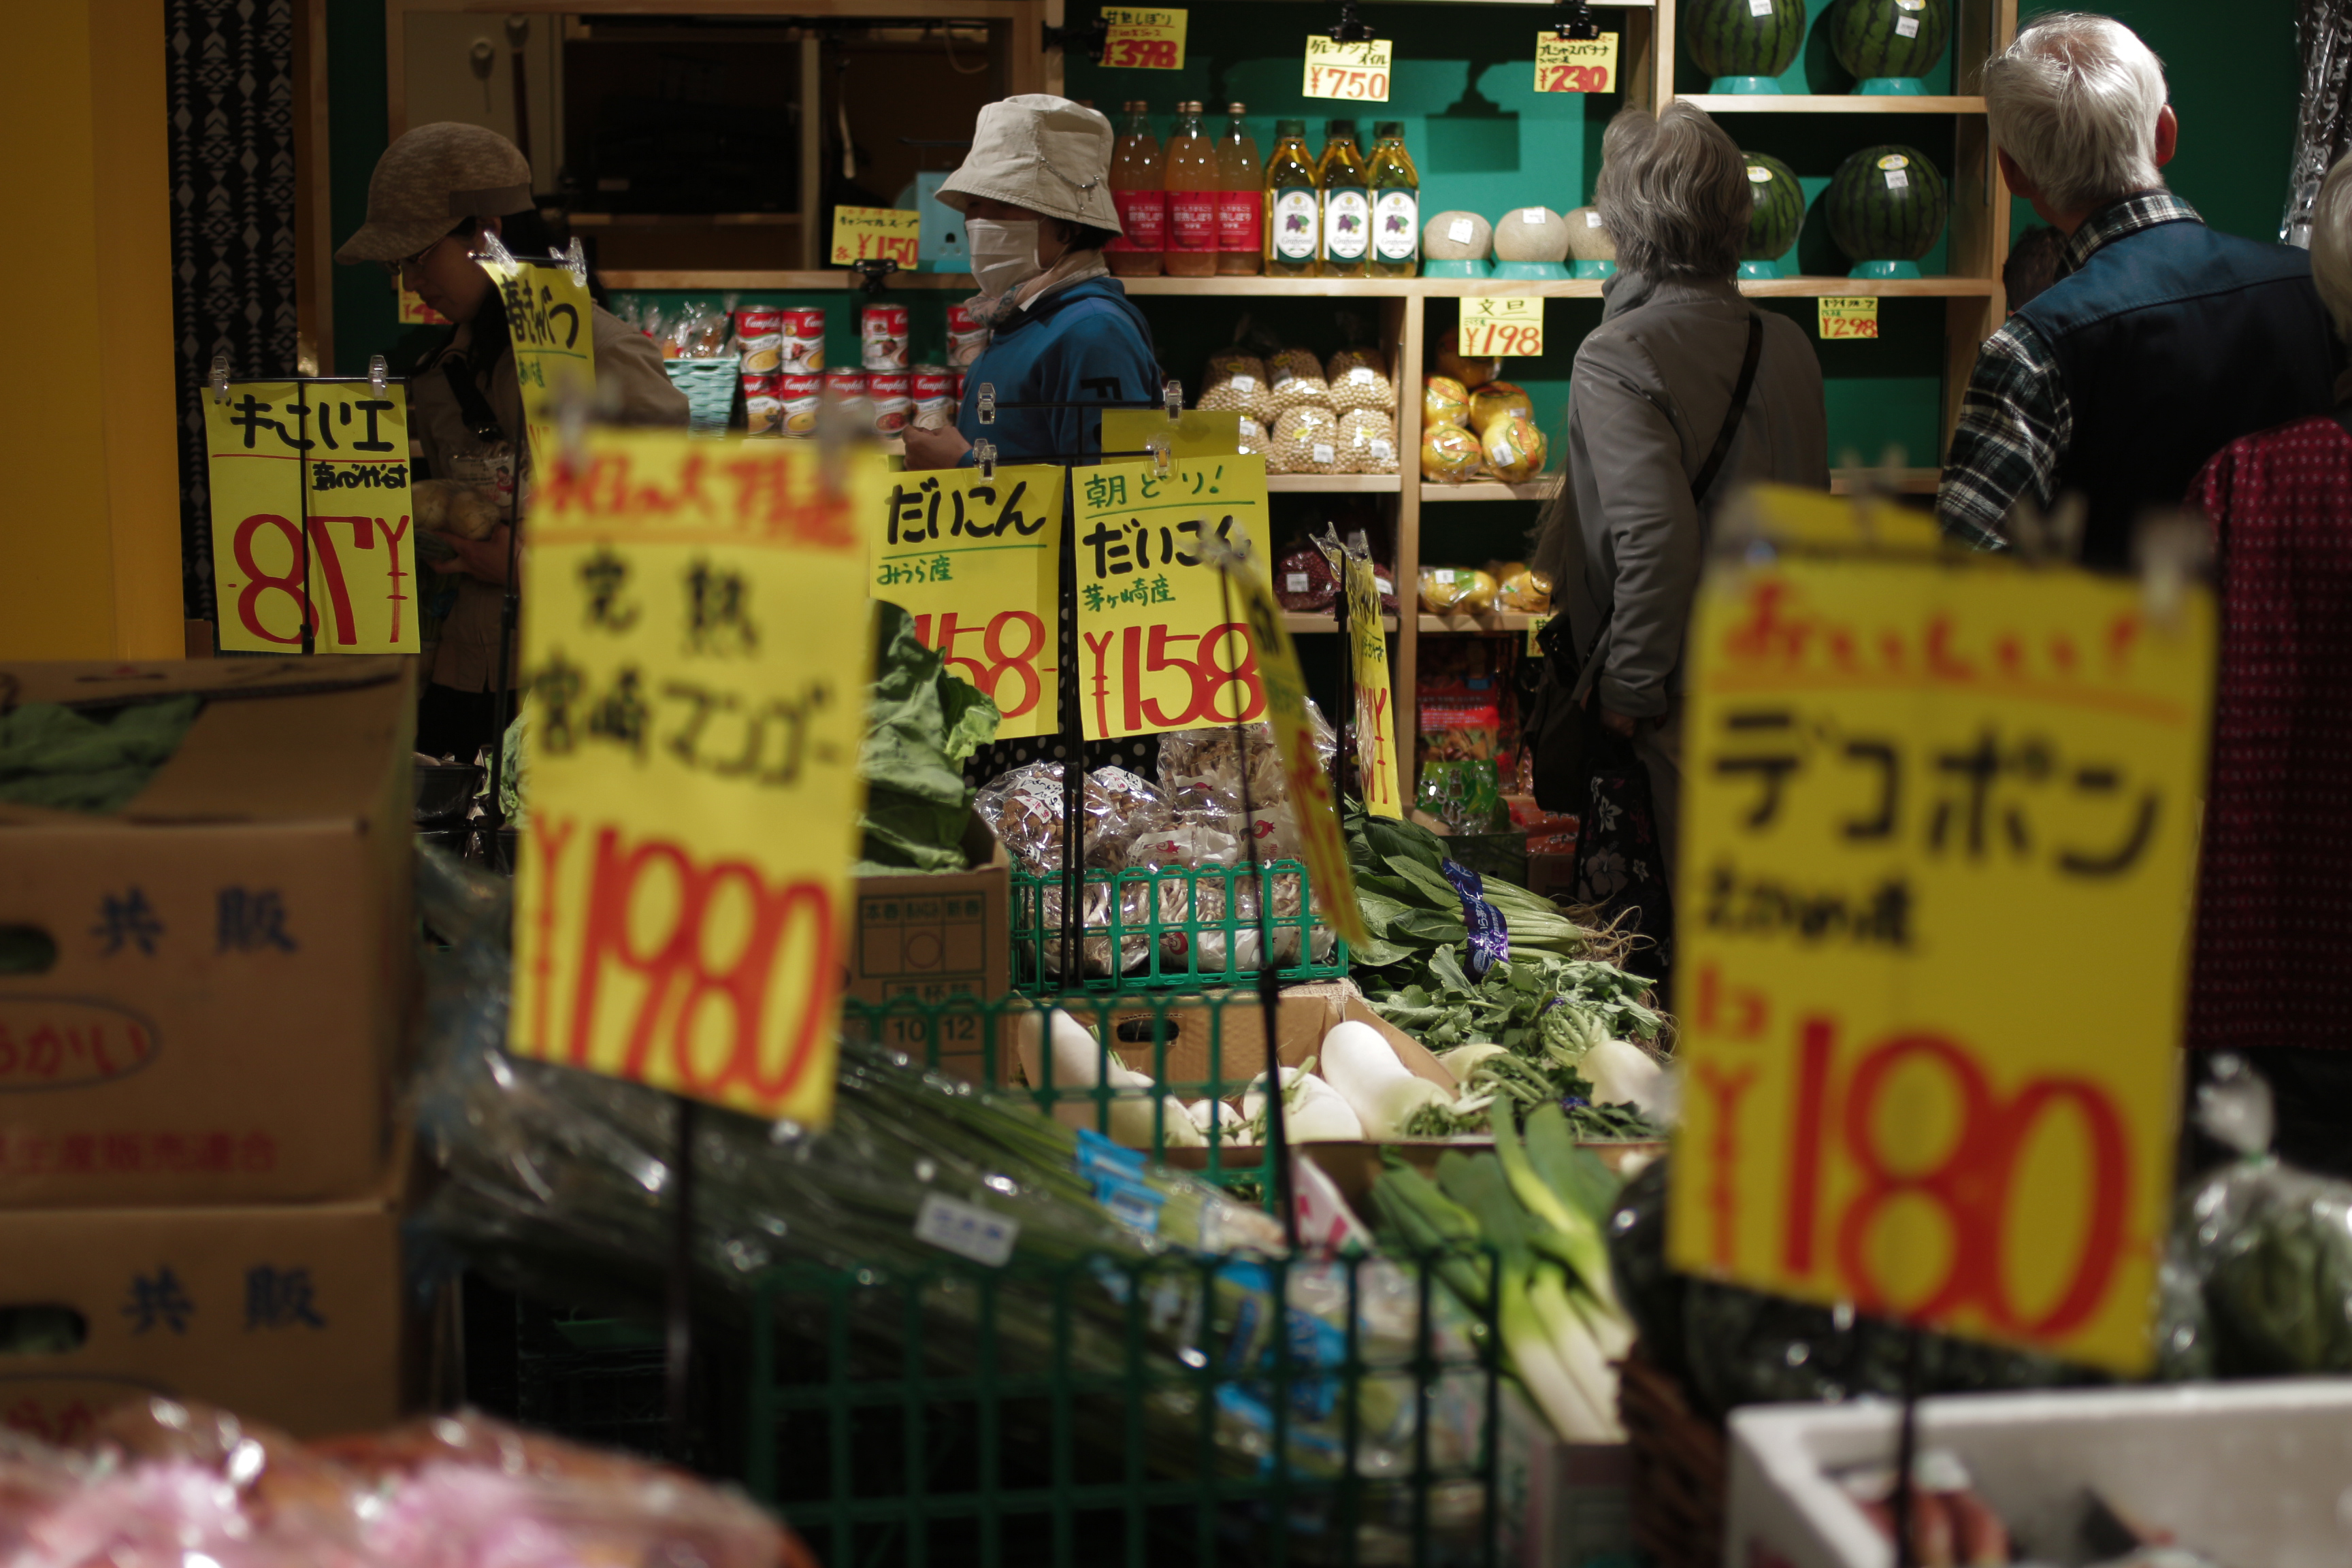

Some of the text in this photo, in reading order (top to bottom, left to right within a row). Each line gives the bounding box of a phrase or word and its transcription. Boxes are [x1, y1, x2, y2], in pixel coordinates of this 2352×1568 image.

[1104, 39, 1178, 67] ¥398
[1311, 66, 1386, 99] ¥750
[1539, 65, 1608, 93] ¥230
[858, 233, 919, 266] ¥150
[1477, 299, 1529, 316] 文旦
[1465, 324, 1542, 357] ¥198
[1823, 318, 1878, 338] ¥298
[1083, 465, 1224, 508] 朝どり!
[885, 477, 1047, 544] だいこん
[877, 555, 953, 585] みうら産
[1081, 574, 1176, 612] 茅ヶ崎産
[1083, 622, 1268, 738] ¥158
[524, 650, 843, 788] 宮崎マンゴー
[1710, 709, 2162, 879] デコポン
[525, 811, 837, 1101] ¥1980
[894, 1015, 975, 1042] 10 12
[1696, 1017, 2130, 1343] ¥180
